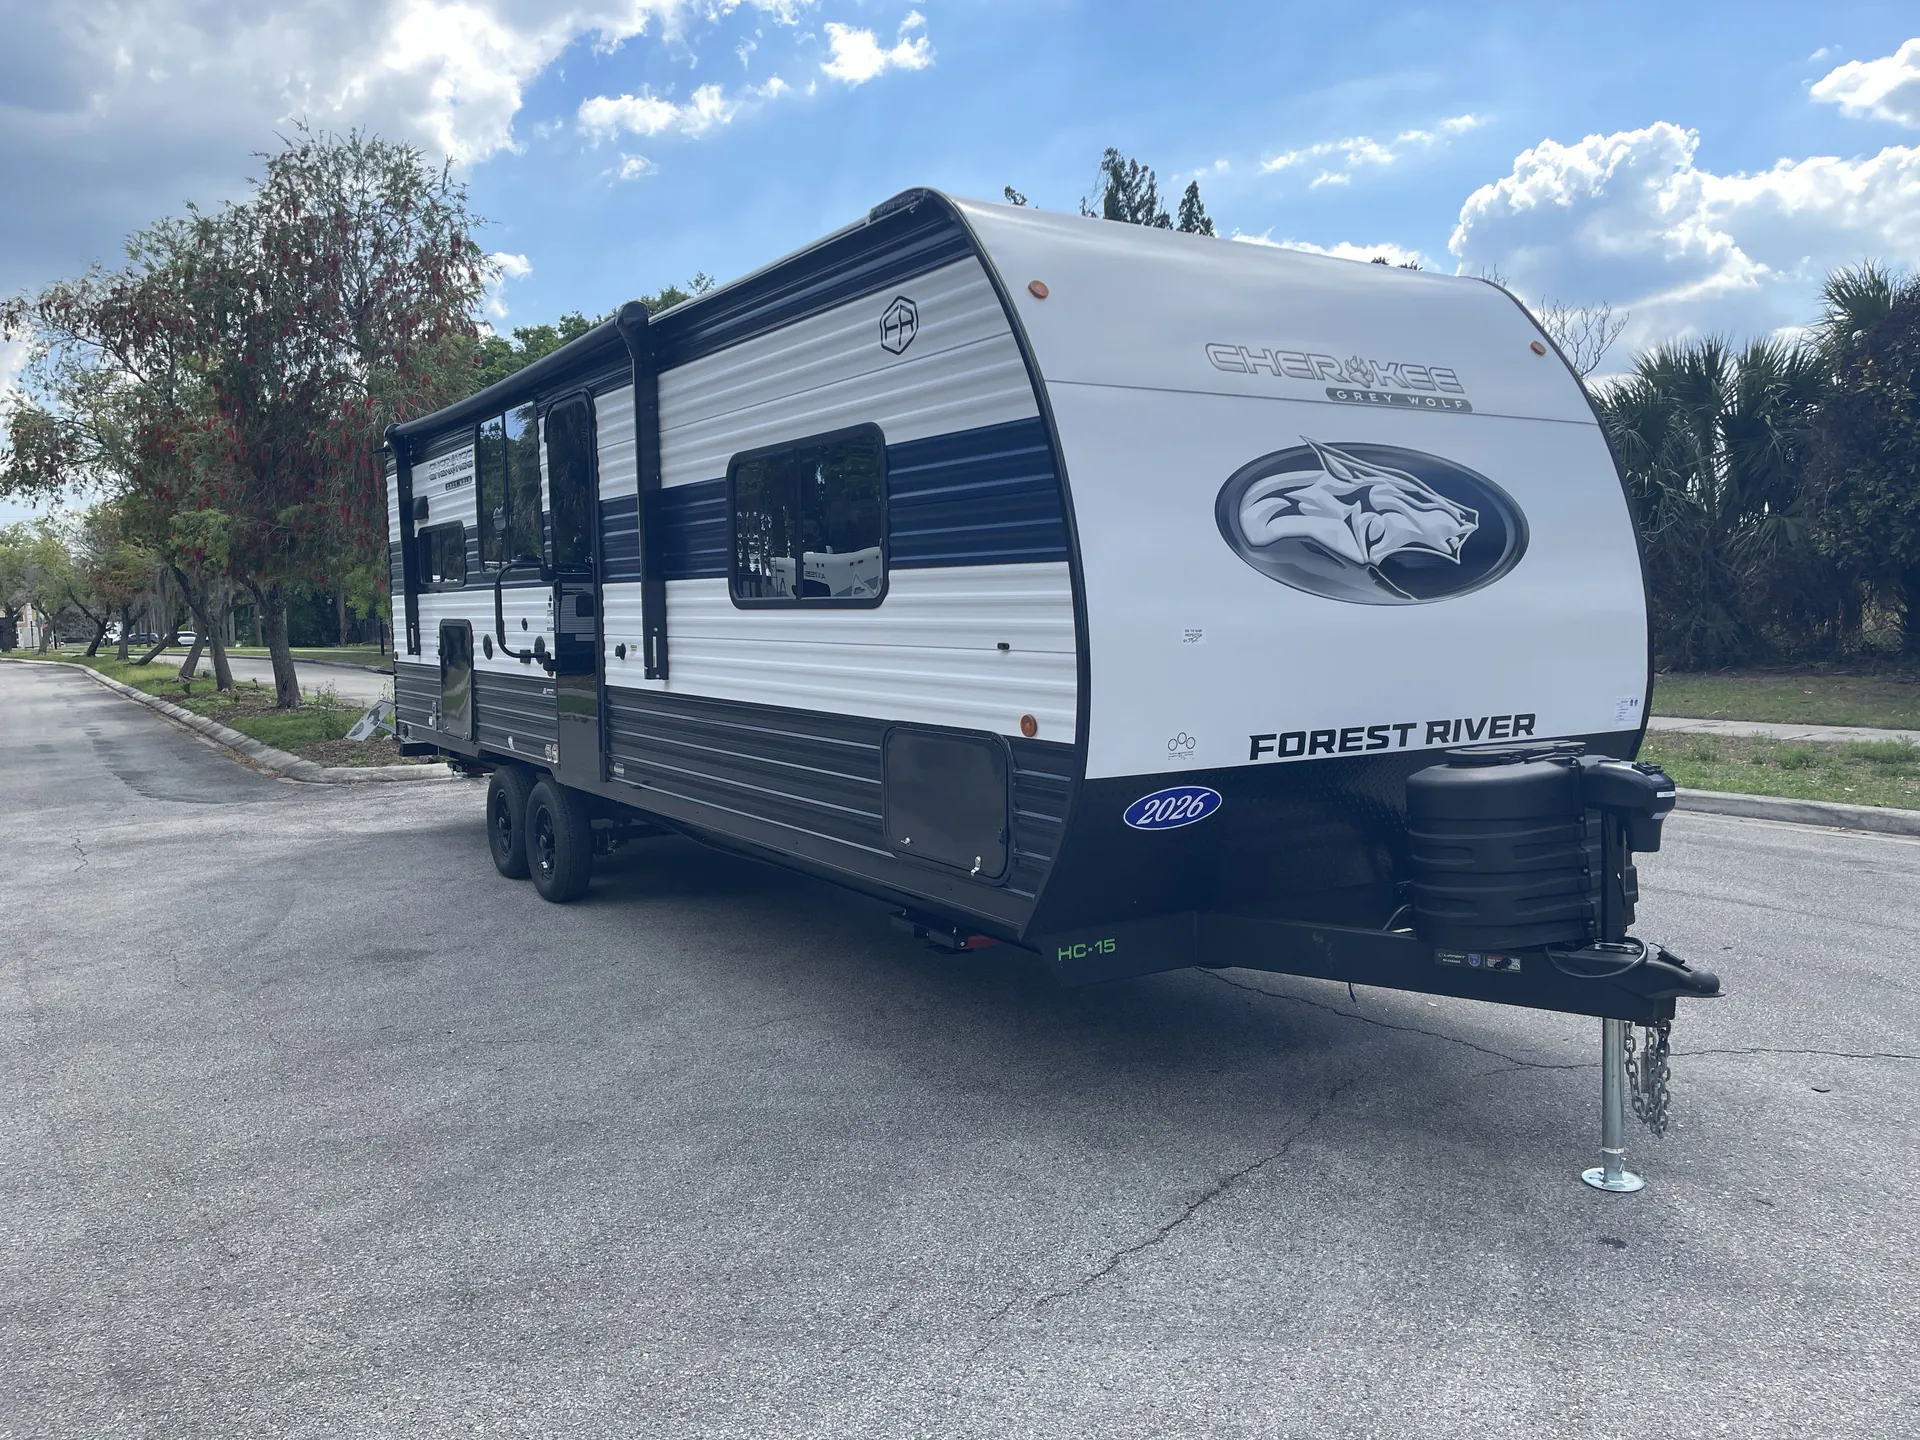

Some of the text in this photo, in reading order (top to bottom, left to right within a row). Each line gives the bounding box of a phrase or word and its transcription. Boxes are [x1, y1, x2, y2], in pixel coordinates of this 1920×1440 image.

[1336, 390, 1463, 409] GREY WOLF
[1249, 713, 1536, 761] FOREST RIVER
[1136, 792, 1211, 825] 2026
